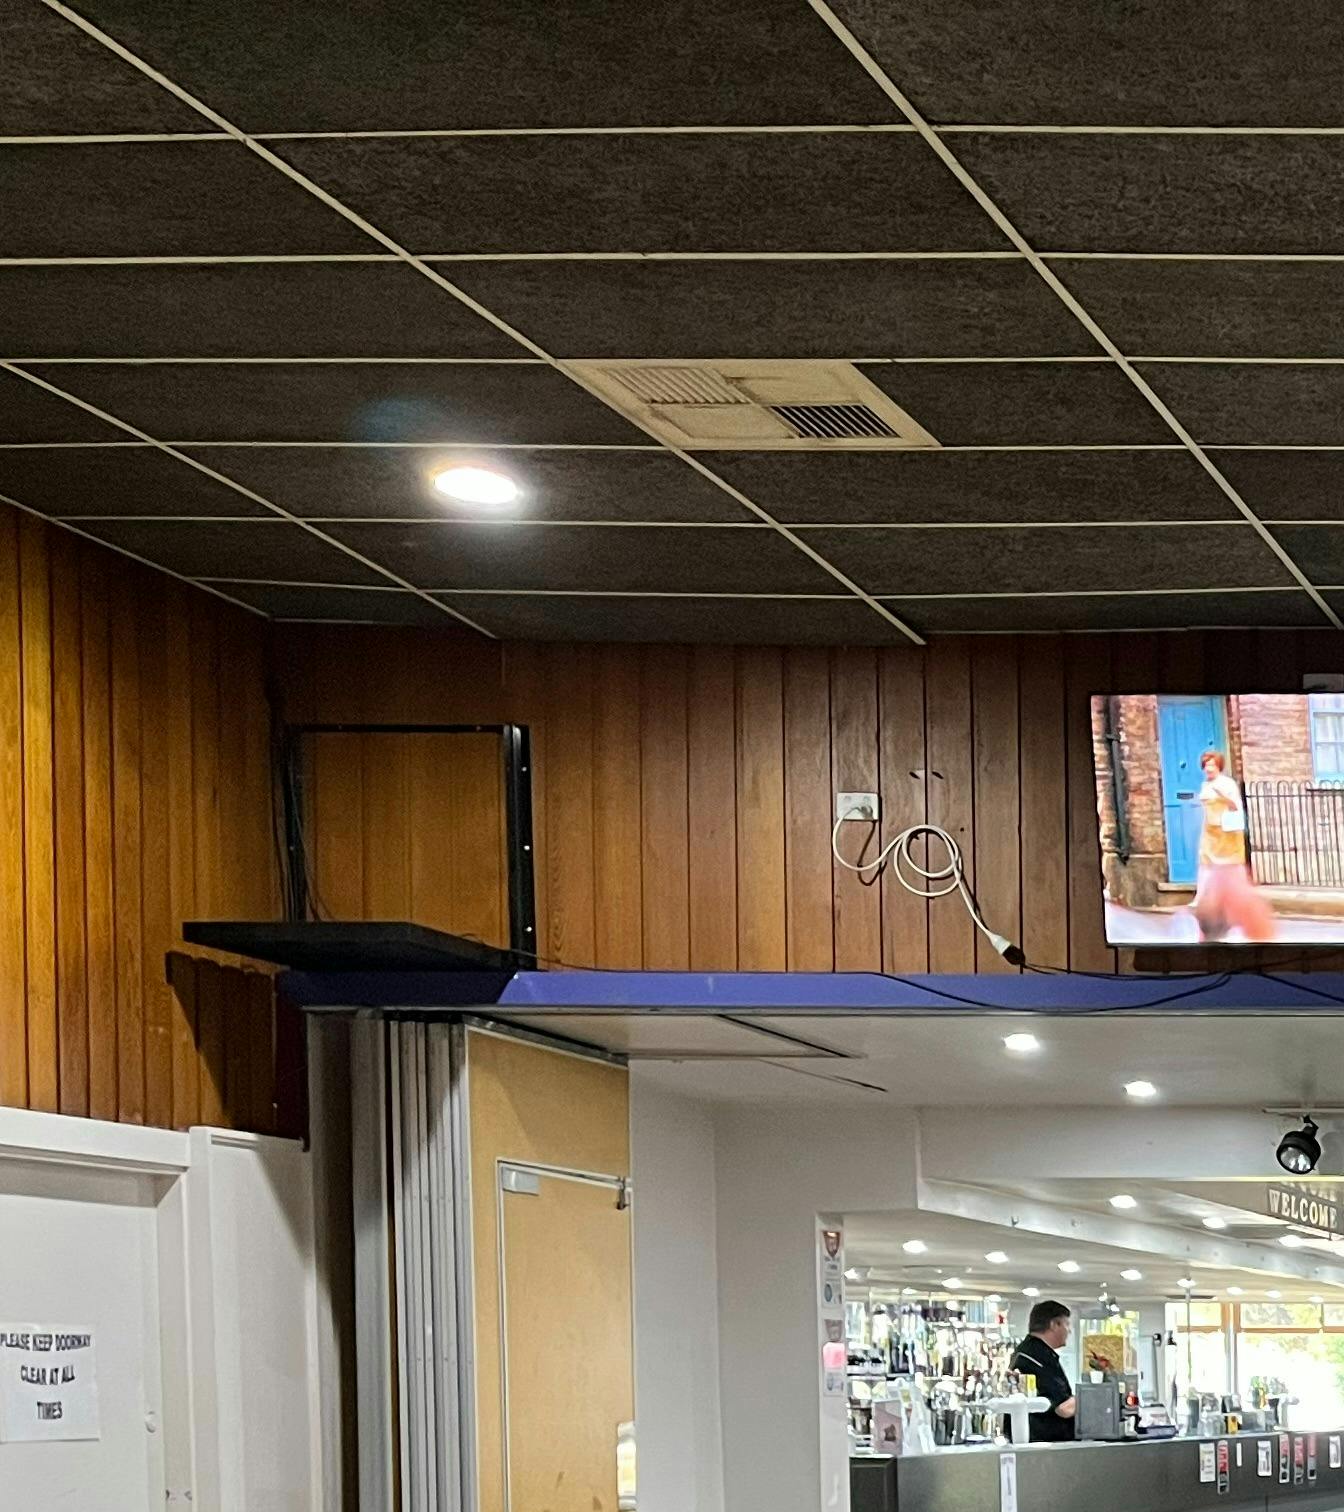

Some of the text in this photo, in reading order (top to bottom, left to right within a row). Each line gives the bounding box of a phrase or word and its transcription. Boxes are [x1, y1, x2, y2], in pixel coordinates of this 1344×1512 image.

[1269, 1189, 1337, 1228] WELCOME
[0, 1333, 30, 1351] PLEASE
[21, 1364, 75, 1385] CLEAR AT ALL
[37, 1401, 62, 1420] TIMES
